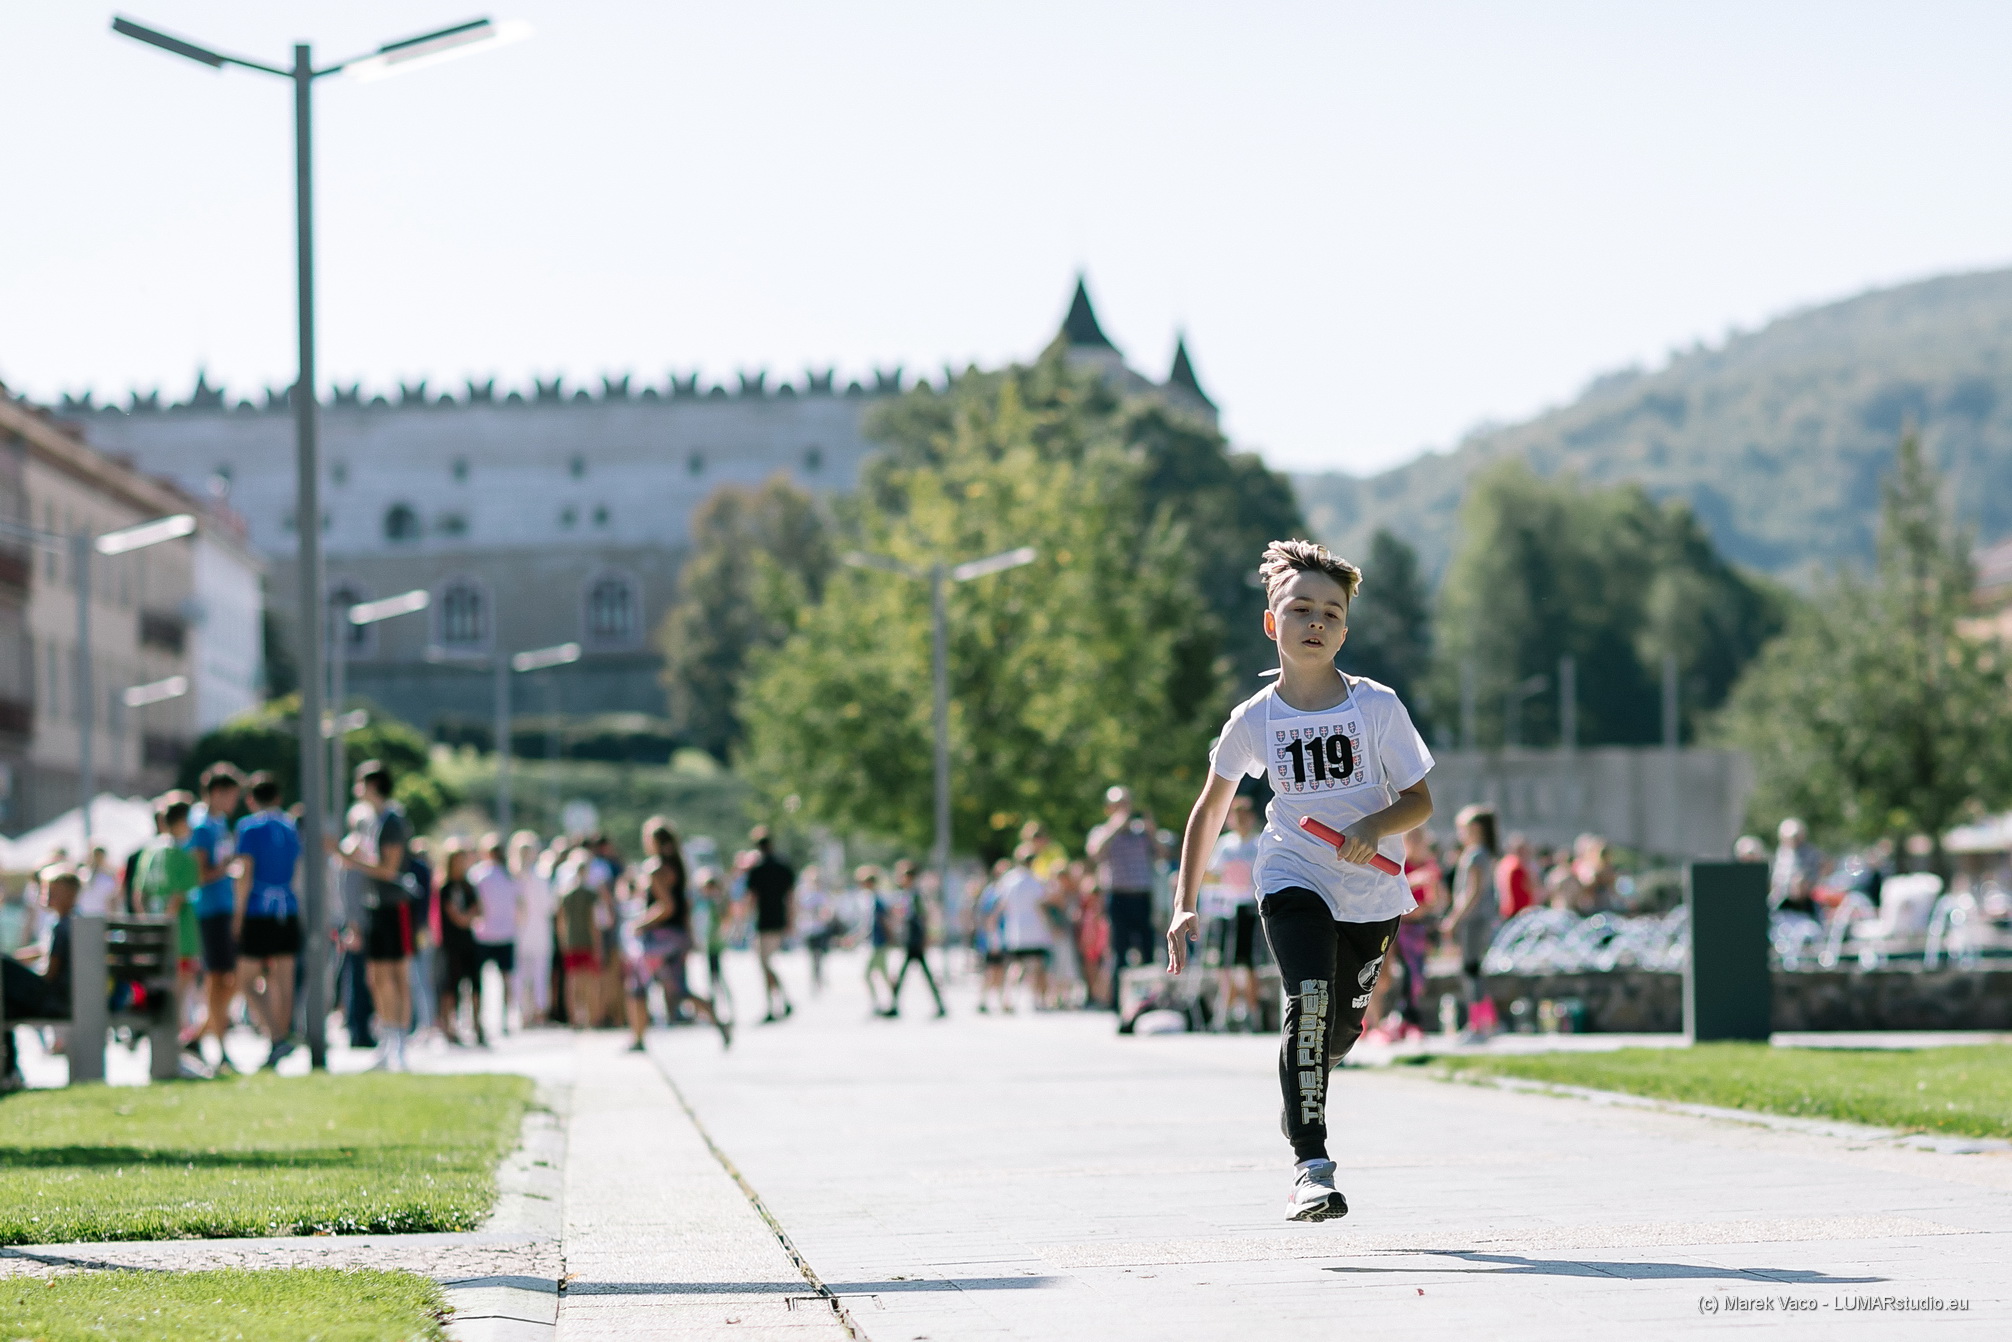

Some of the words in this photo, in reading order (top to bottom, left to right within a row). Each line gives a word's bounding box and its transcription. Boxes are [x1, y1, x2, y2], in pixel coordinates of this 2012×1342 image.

[1285, 734, 1354, 783] 119
[1297, 979, 1319, 1067] POWER
[1315, 1019, 1326, 1065] DARK
[1298, 1071, 1318, 1125] THE
